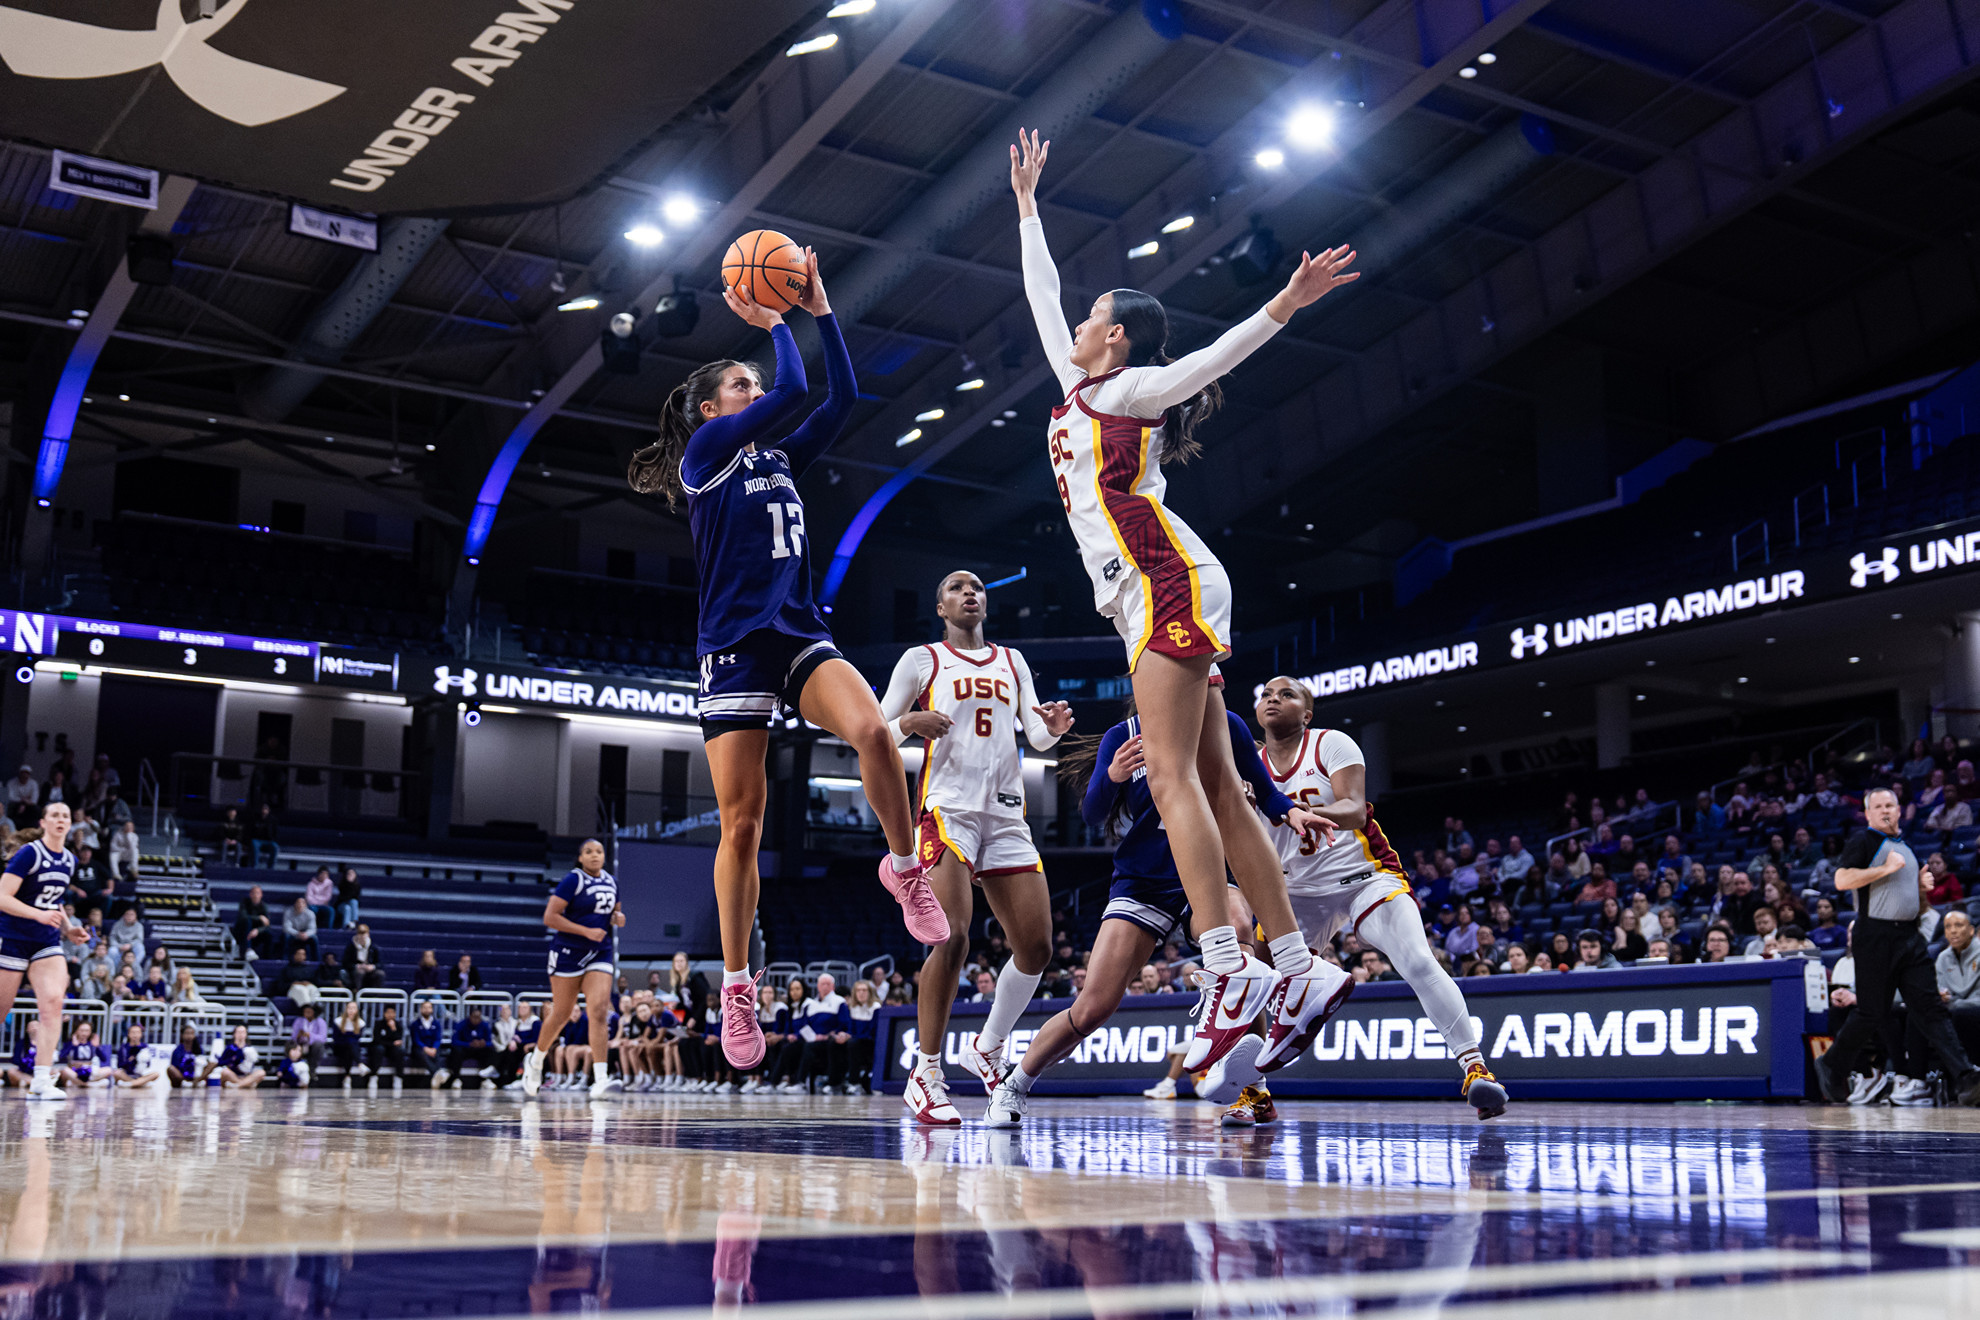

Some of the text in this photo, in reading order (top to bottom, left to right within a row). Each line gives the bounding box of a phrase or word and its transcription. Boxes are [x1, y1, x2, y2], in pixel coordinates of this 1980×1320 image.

[330, 87, 476, 192] UNDER
[329, 221, 341, 237] N
[1051, 429, 1075, 467] SC
[767, 502, 805, 559] 12
[1554, 570, 1805, 648] UNDER ARMOUR
[13, 612, 45, 655] N
[75, 621, 120, 635] BLOCKS
[89, 638, 105, 656] 0
[183, 648, 198, 665] 3
[253, 640, 310, 656] REBOUNDS
[273, 657, 287, 675] 3
[1298, 641, 1479, 699] NDER ARMOUR
[485, 673, 595, 706] UNDER
[953, 676, 1010, 707] USC
[975, 707, 993, 738] 6
[34, 885, 65, 910] 22
[593, 892, 616, 914] 23
[1489, 1005, 1759, 1058] ARMOUR
